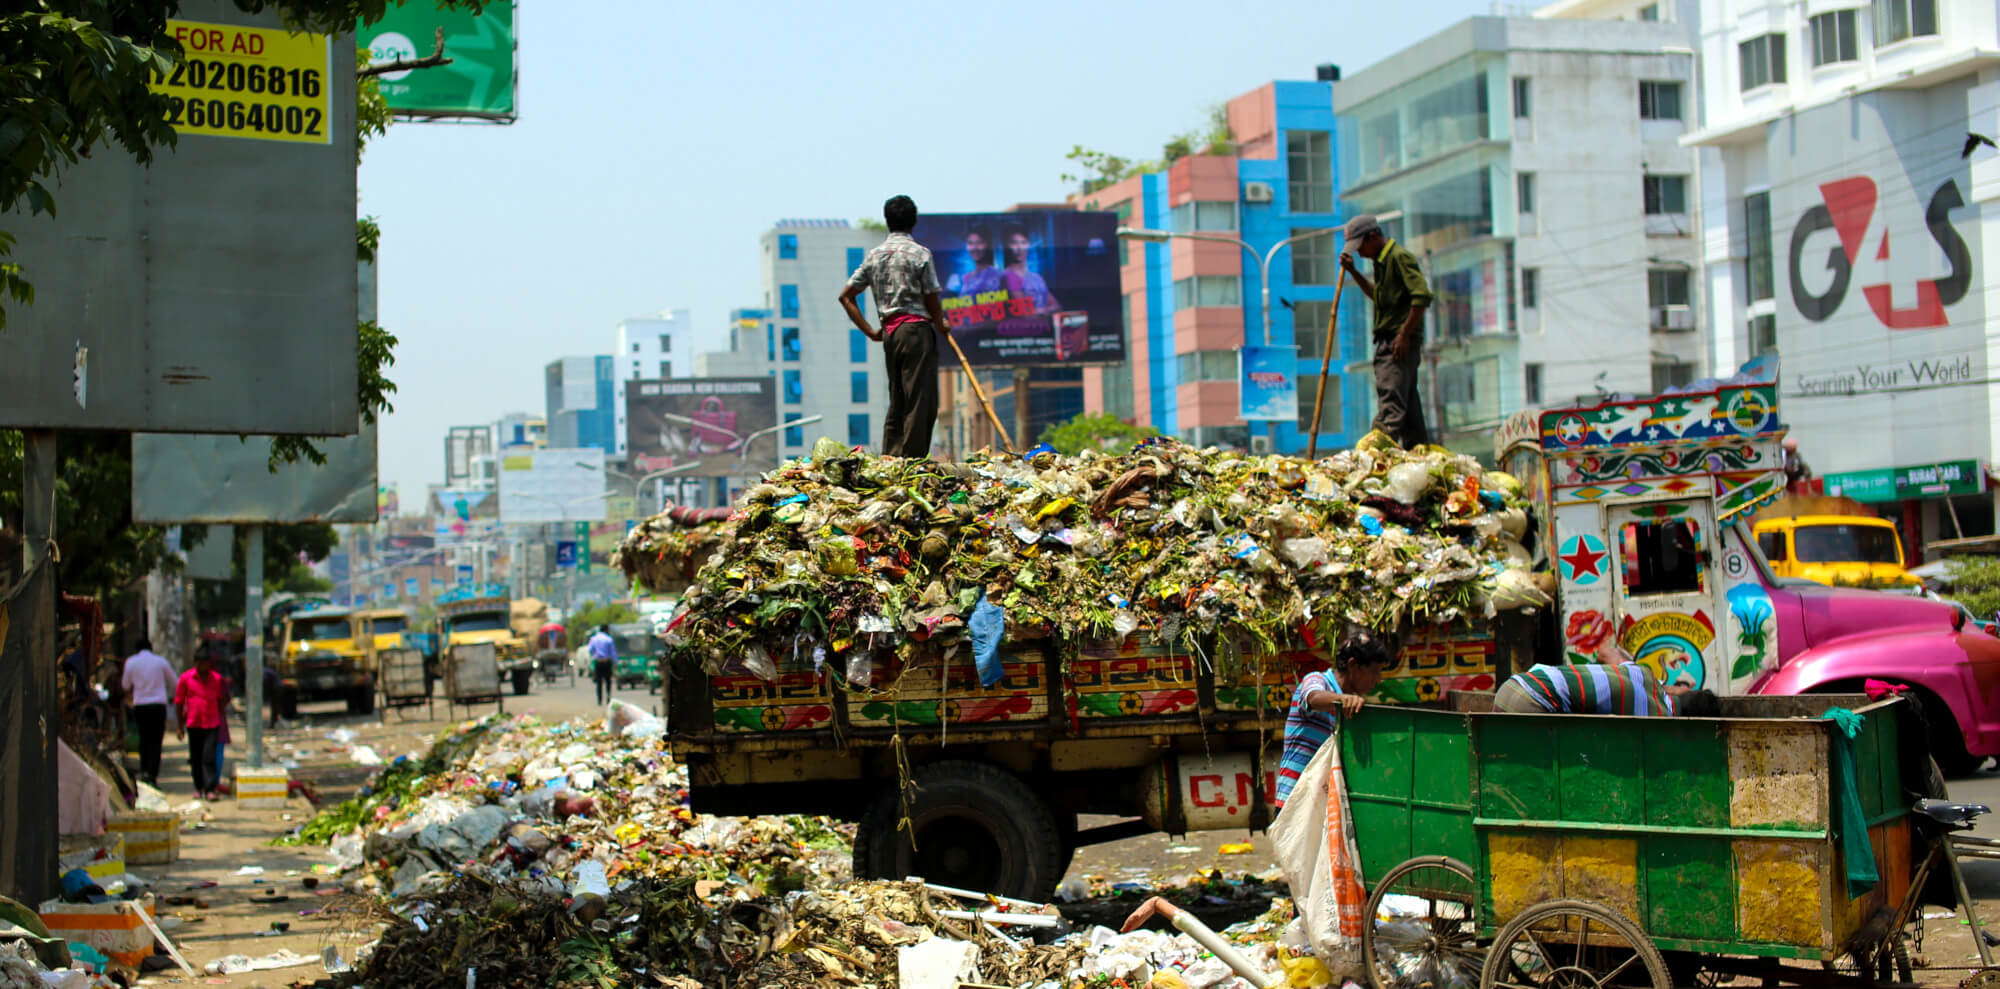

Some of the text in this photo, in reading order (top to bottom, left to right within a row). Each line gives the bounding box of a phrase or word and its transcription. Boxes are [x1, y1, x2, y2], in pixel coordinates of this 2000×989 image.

[176, 27, 264, 55] FOR AD
[147, 59, 320, 98] 20206816
[160, 96, 322, 136] 26064002
[1789, 175, 1973, 331] G4S
[976, 289, 1008, 305] MOM
[1797, 355, 1970, 394] Securing Your World
